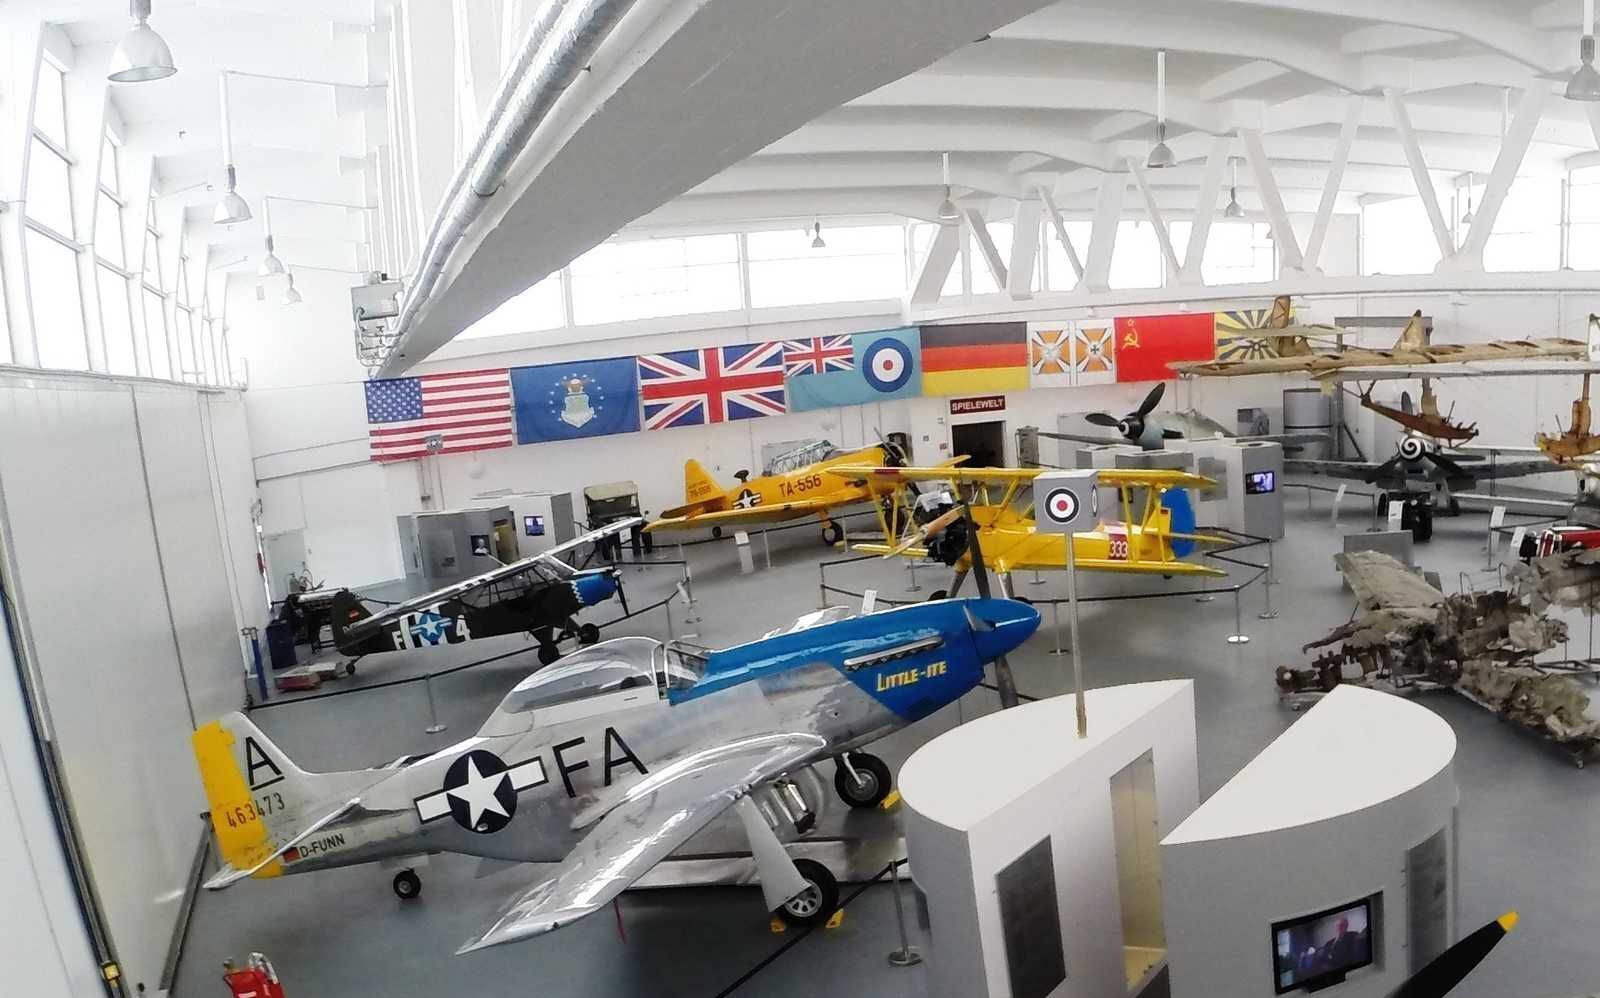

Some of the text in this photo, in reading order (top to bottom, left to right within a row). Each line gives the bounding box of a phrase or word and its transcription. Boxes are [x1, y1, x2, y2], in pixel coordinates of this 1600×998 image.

[951, 399, 1003, 411] SPIELEWELT
[1109, 541, 1128, 558] 333
[246, 737, 283, 787] A
[552, 727, 649, 798] FA
[226, 793, 285, 829] 463473
[300, 834, 345, 859] D-FUNN
